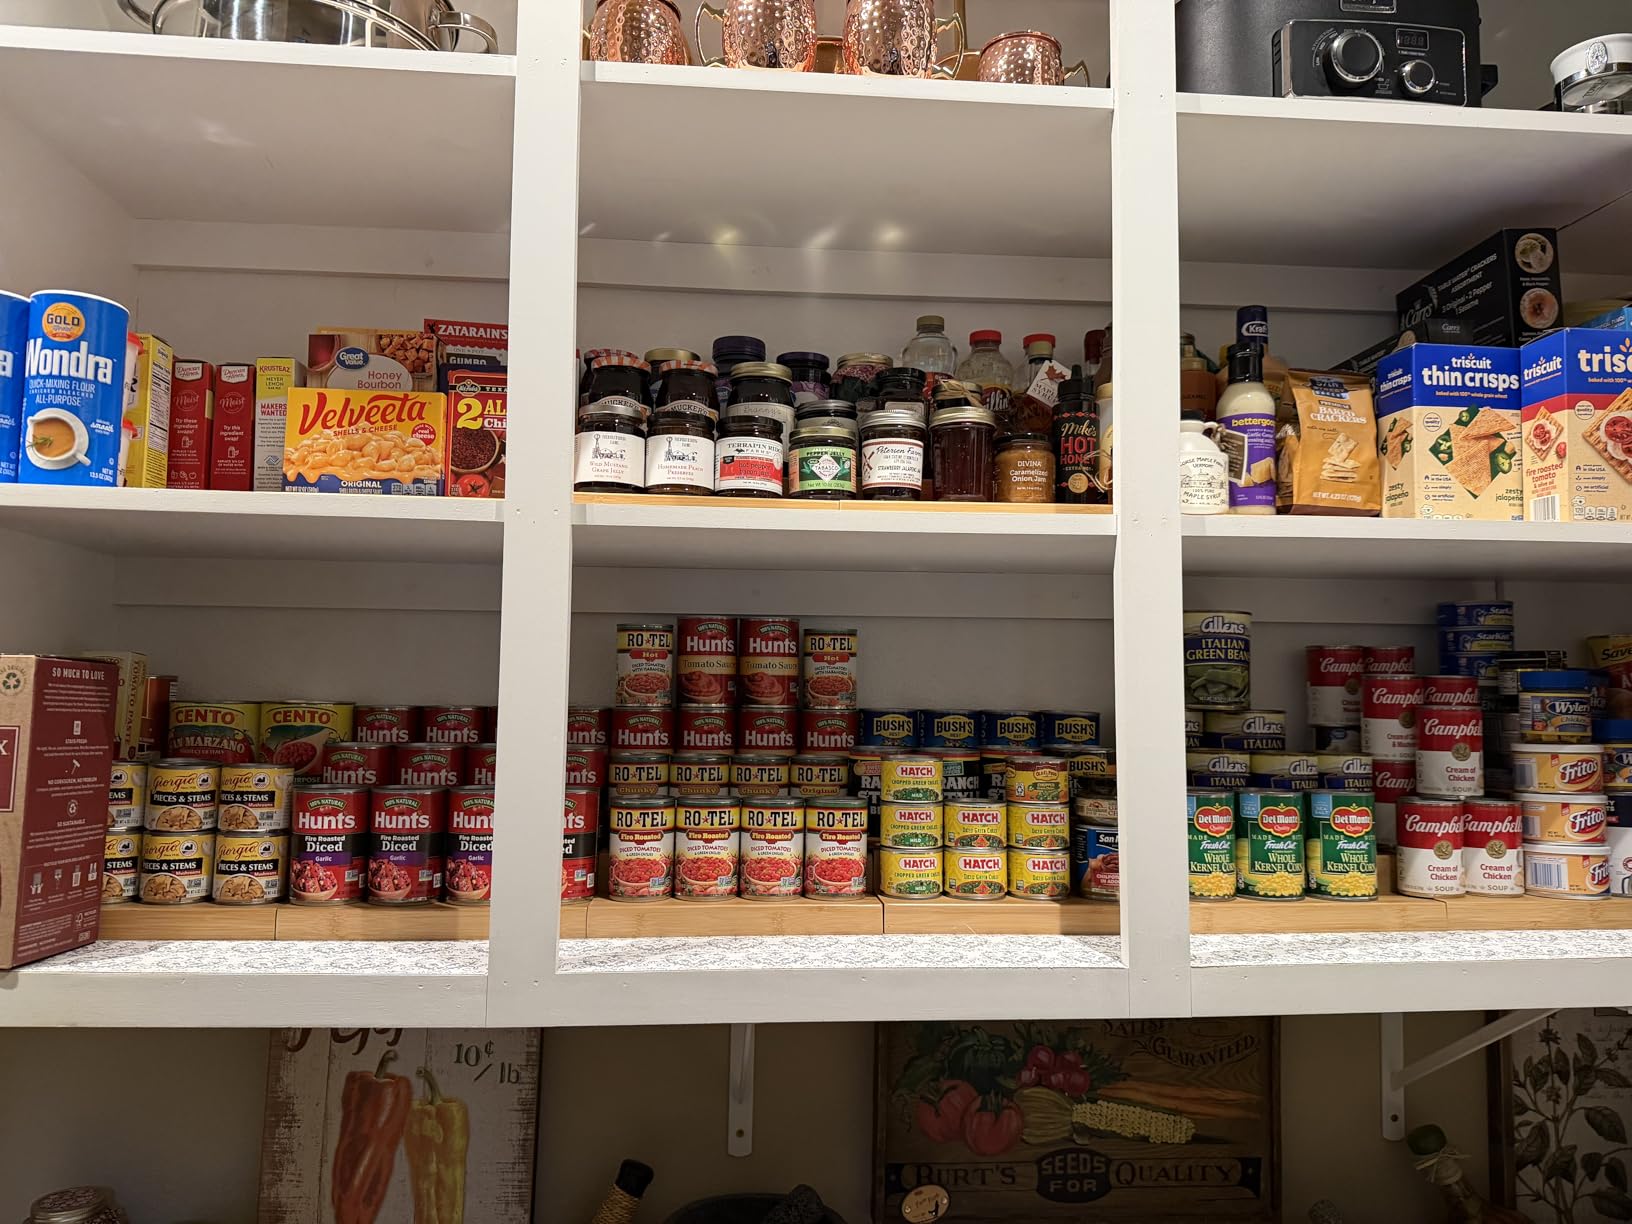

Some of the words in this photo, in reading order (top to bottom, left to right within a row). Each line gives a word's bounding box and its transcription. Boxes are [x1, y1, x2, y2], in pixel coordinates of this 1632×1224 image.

[47, 314, 80, 326] GOLD
[438, 324, 508, 339] ZATARAIN'S
[25, 338, 112, 384] Wondra
[339, 352, 363, 362] Great
[1451, 356, 1492, 369] triscuit
[259, 365, 291, 374] KRUSTEAZ
[1523, 356, 1562, 380] triscuit
[368, 371, 403, 381] Honey
[1422, 365, 1462, 386] thin
[1465, 371, 1519, 391] crisps
[72, 381, 95, 393] FLOUR
[357, 380, 401, 389] Bourbon
[35, 394, 81, 406] ALL-PURPOSE
[299, 392, 427, 435] Velveeta
[456, 398, 482, 429] 2
[1319, 406, 1355, 416] BAKED
[1310, 413, 1367, 424] CRACKERS
[333, 428, 360, 437] SHELLS
[369, 424, 398, 434] CHEESE
[1061, 420, 1096, 436] Mike's
[1061, 438, 1096, 453] HOT
[1060, 454, 1095, 464] HONEY
[1538, 460, 1563, 473] roasted
[1532, 472, 1556, 483] tomato
[340, 480, 382, 489] ORIGINAL
[1201, 616, 1245, 634] Allens
[1202, 639, 1245, 649] ITALIAN
[641, 651, 659, 659] Hot
[1186, 650, 1224, 661] GREEN
[681, 659, 714, 669] Tomato
[52, 667, 61, 677] SO
[63, 668, 80, 679] MUCH
[82, 670, 89, 679] TO
[91, 670, 104, 680] LOVE
[175, 709, 235, 724] CENTO
[272, 709, 332, 724] CENTO
[876, 720, 912, 733] BUSH'S
[937, 721, 972, 734] BUSH'S
[999, 721, 1036, 736] BUSH'S
[1243, 719, 1282, 734] Allens
[185, 736, 245, 753] MARZANO
[1243, 738, 1283, 749] ITALIAN
[900, 766, 933, 776] HATCH
[1446, 765, 1470, 774] Cream
[1470, 765, 1476, 774] of
[1560, 758, 1598, 781] Fritos
[153, 773, 196, 789] Giorgio
[943, 775, 979, 789] RANCH
[1210, 777, 1247, 787] ITALIAN
[1447, 773, 1476, 783] Chicken
[619, 786, 655, 794] Chunky
[681, 786, 717, 794] Chunky
[741, 786, 777, 795] Chunky
[802, 786, 839, 795] Original
[153, 794, 176, 803] PIECES
[243, 793, 269, 802] STEMS
[899, 811, 932, 821] HATCH
[1198, 814, 1209, 824] Del
[1210, 815, 1232, 824] Monte
[1262, 814, 1273, 824] Del
[1274, 815, 1297, 824] Monte
[1571, 808, 1605, 831] Fritos
[635, 833, 662, 841] Roasted
[1099, 834, 1114, 843] San
[306, 841, 343, 852] Diced
[381, 841, 417, 851] Diced
[1204, 853, 1230, 863] WHOLE
[1269, 852, 1296, 863] WHOLE
[1340, 853, 1368, 863] WHOLE
[106, 860, 133, 869] STEMS
[903, 859, 936, 869] HATCH
[1255, 861, 1285, 872] KERNEL
[1327, 862, 1358, 872] KERNEL
[1359, 862, 1375, 872] CORN
[1427, 864, 1451, 873] Cream
[1451, 864, 1458, 872] of
[1480, 863, 1504, 872] Cream
[1430, 872, 1458, 881] Chicken
[1482, 872, 1512, 881] Chicken
[1487, 884, 1508, 892] SOUP
[1150, 1034, 1256, 1068] GUARANTEED
[1041, 1154, 1105, 1174] SEEDS
[914, 1162, 1017, 1188] BURT'S
[1115, 1161, 1235, 1184] QUALITY
[1050, 1181, 1096, 1192] FOR
